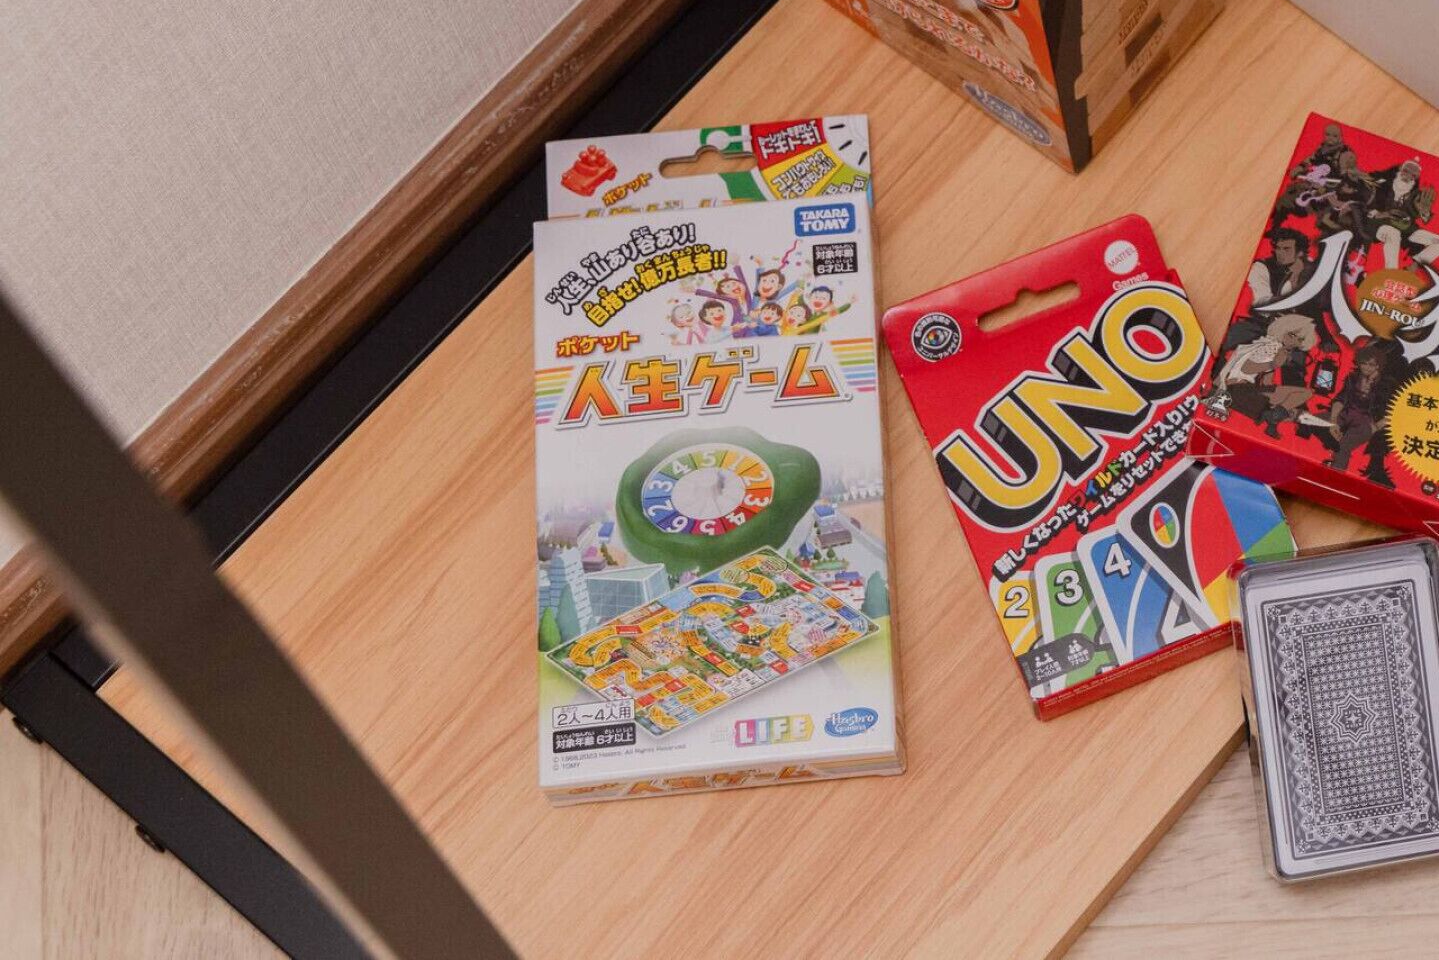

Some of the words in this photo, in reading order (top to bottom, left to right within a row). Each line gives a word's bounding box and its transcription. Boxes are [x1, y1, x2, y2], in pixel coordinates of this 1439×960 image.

[602, 172, 653, 208] ポケット
[799, 207, 850, 221] TAKARA
[799, 218, 850, 233] TOMY
[556, 329, 641, 359] ポケット
[560, 344, 843, 425] 人生ゲーム
[940, 285, 1206, 522] UNO
[701, 452, 716, 468] 5
[1103, 541, 1133, 578] 4
[1003, 584, 1032, 620] 2
[1053, 569, 1085, 609] 3
[737, 717, 810, 744] LIFE
[830, 711, 874, 726] Hasbro
[555, 736, 595, 750] 対象年齢
